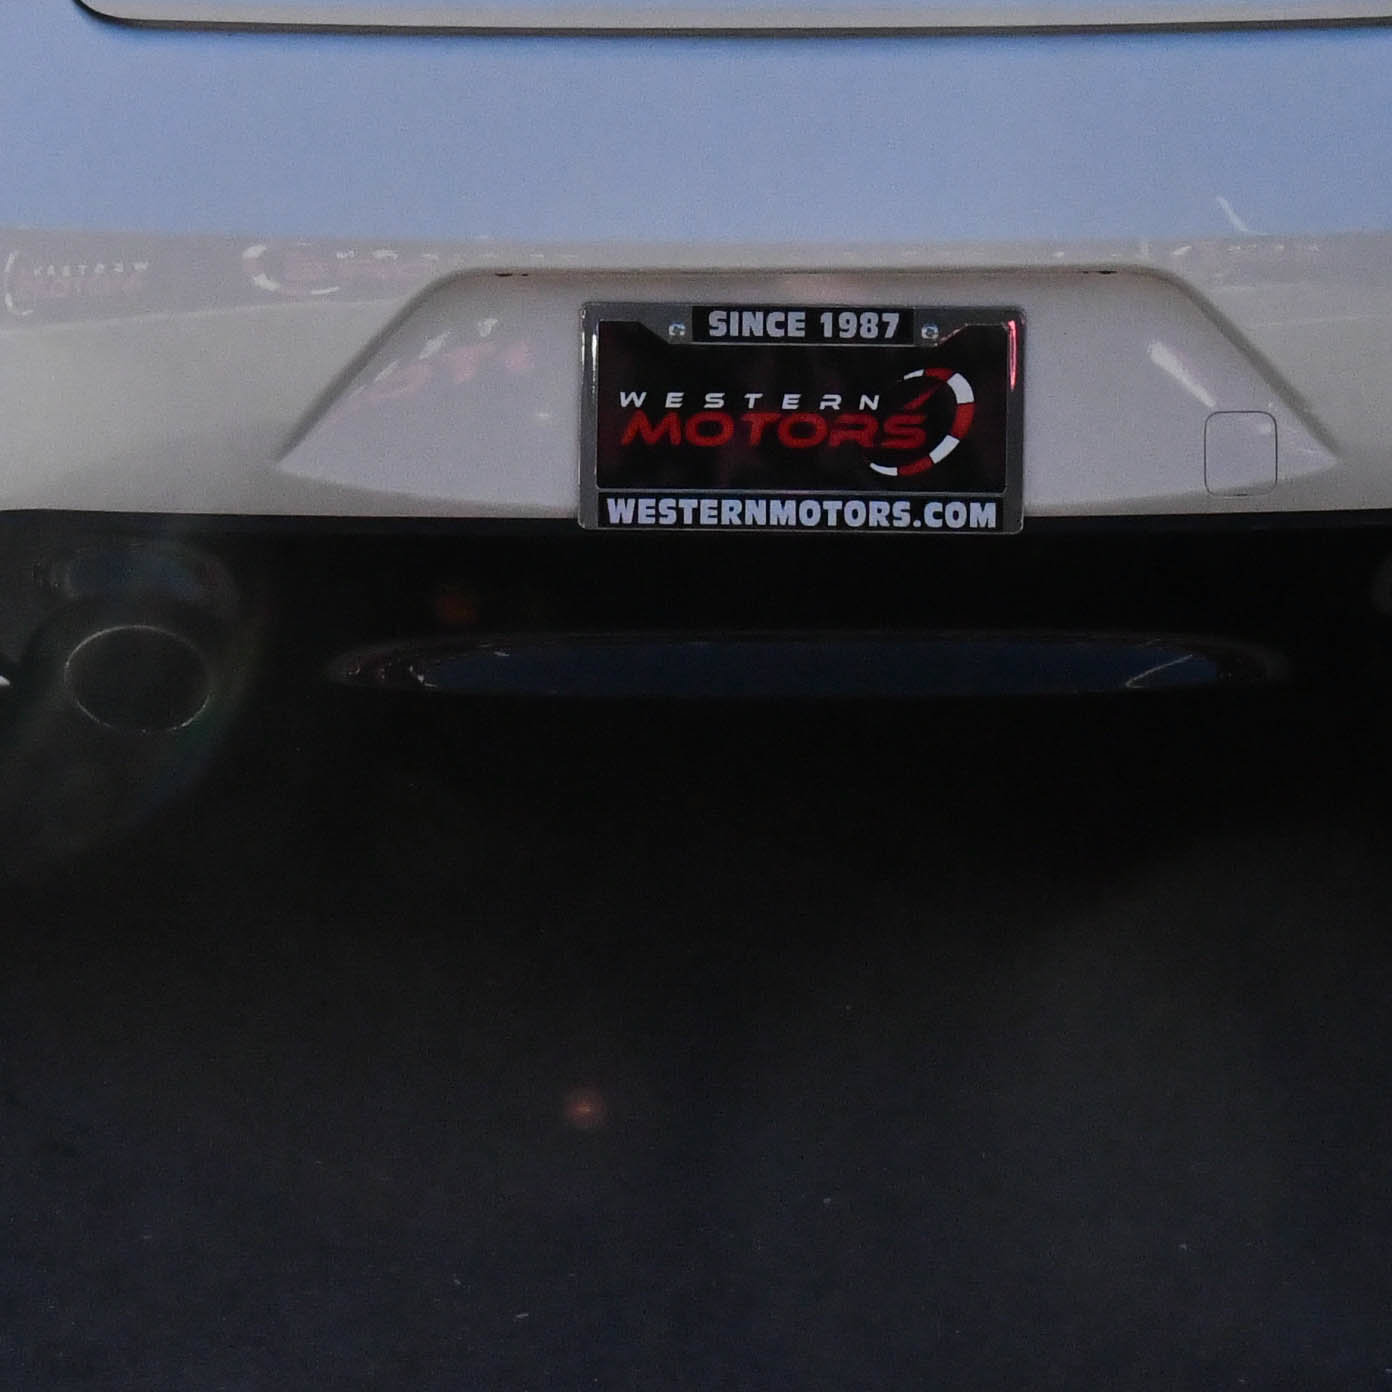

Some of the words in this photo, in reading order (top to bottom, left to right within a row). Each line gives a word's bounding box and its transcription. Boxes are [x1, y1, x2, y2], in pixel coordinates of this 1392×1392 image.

[708, 310, 806, 338] SINCE
[820, 311, 900, 339] 1987
[619, 390, 880, 411] WESTERN
[620, 412, 928, 450] MOTORS
[607, 498, 997, 529] WESTERNMOTORS.COM
